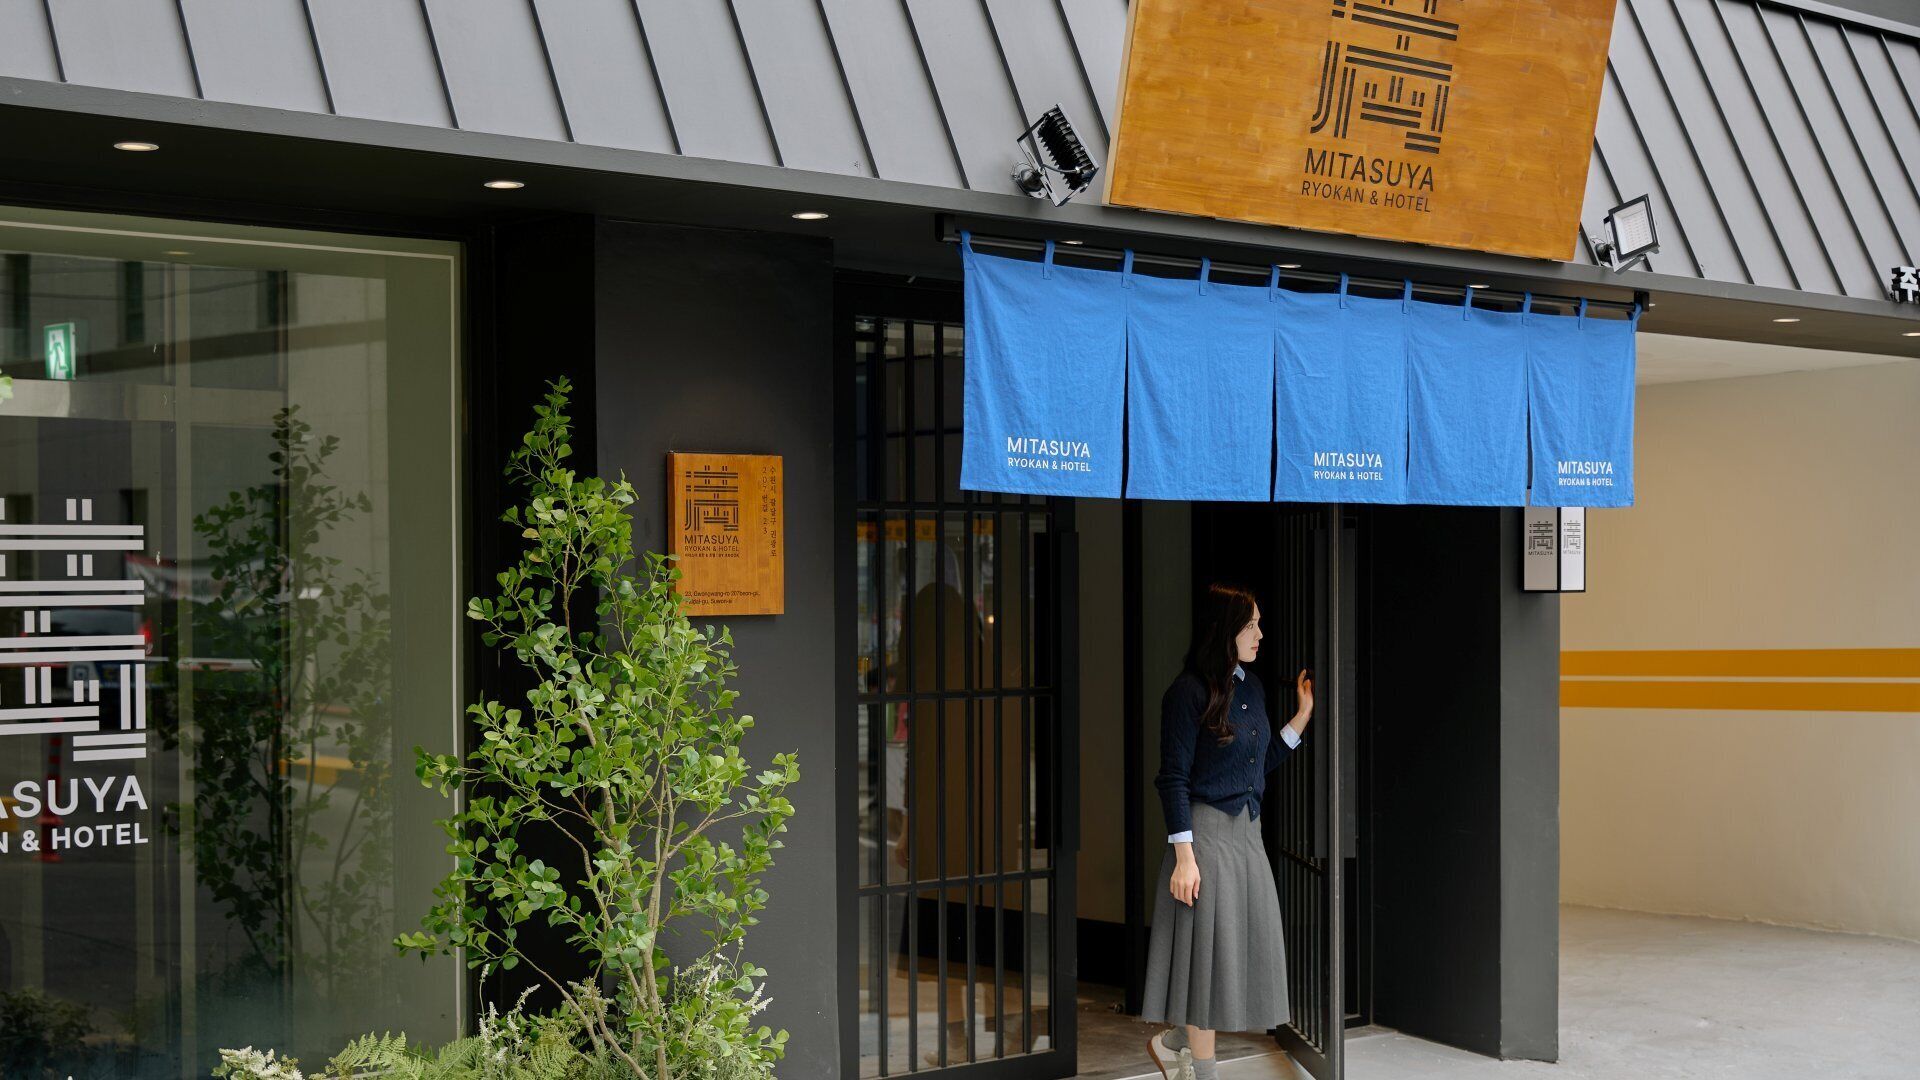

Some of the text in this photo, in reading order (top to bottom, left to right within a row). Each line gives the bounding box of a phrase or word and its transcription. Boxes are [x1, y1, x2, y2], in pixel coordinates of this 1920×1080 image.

[1304, 147, 1434, 192] MITASUYA
[1301, 180, 1431, 213] RYOKAN & HOTEL
[1007, 436, 1091, 458] MITASUYA
[1007, 457, 1092, 472] RYOKAN & HOTEL
[1314, 452, 1383, 468] MITASUYA
[1558, 461, 1613, 475] MITASUYA
[1314, 470, 1384, 481] RYOKAN & HOTEL
[1558, 477, 1585, 486] RYOKAN
[1592, 477, 1613, 486] HOTEL
[684, 534, 739, 545] MITASUYA
[0, 775, 149, 820] SUYA
[21, 829, 41, 852] &
[51, 822, 149, 850] HOTEL
